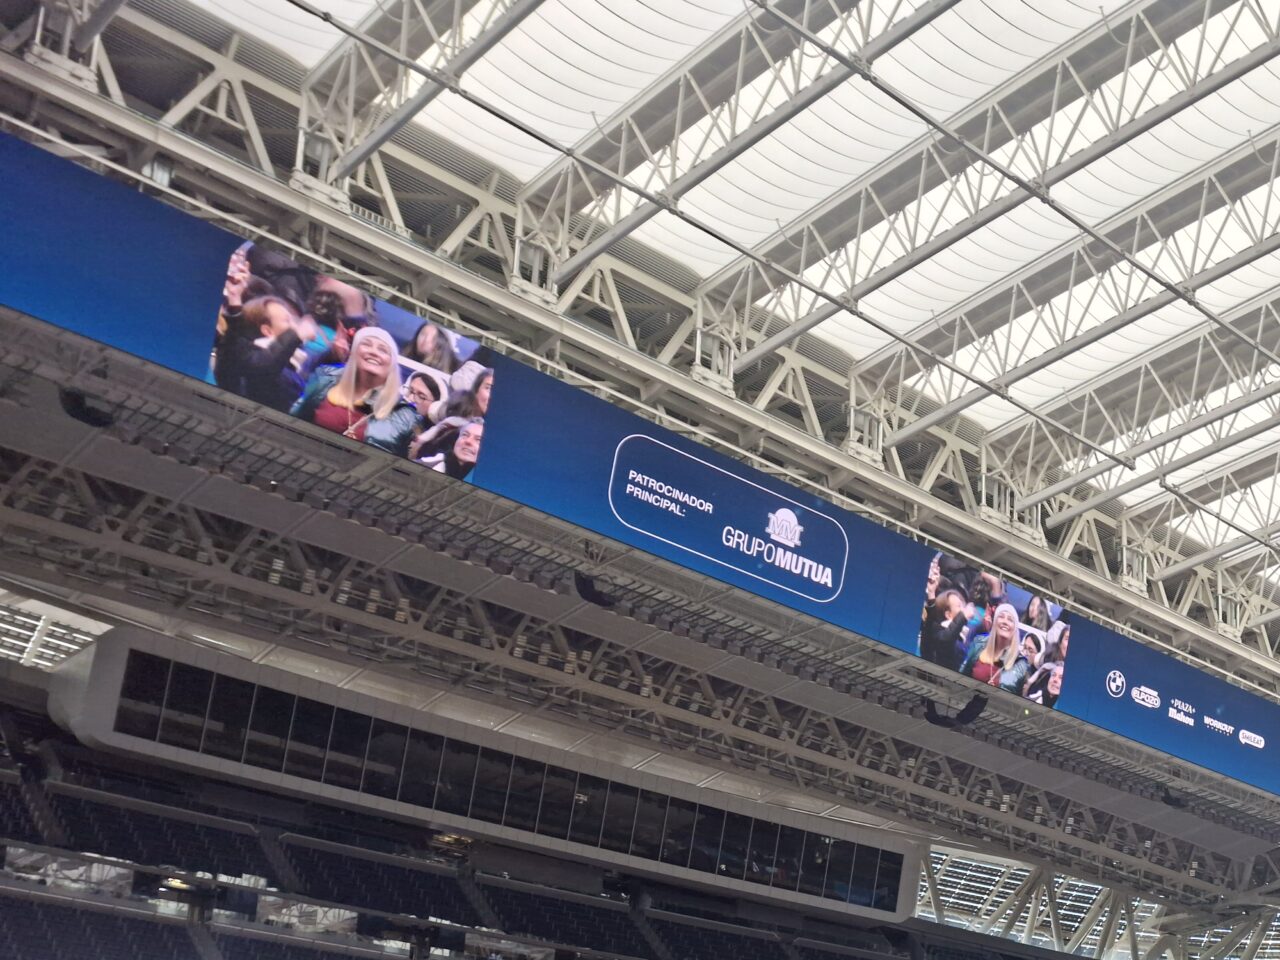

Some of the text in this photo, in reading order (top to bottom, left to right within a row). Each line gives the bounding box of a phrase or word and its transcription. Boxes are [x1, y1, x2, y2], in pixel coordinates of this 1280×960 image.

[626, 484, 686, 517] PRINCIPAL:
[628, 470, 713, 514] PATROCINADOR
[721, 525, 833, 587] GRUPOMUTUA
[1168, 707, 1195, 726] Mahou
[1174, 698, 1193, 714] PLAZA
[1204, 715, 1235, 734] WORKOUT
